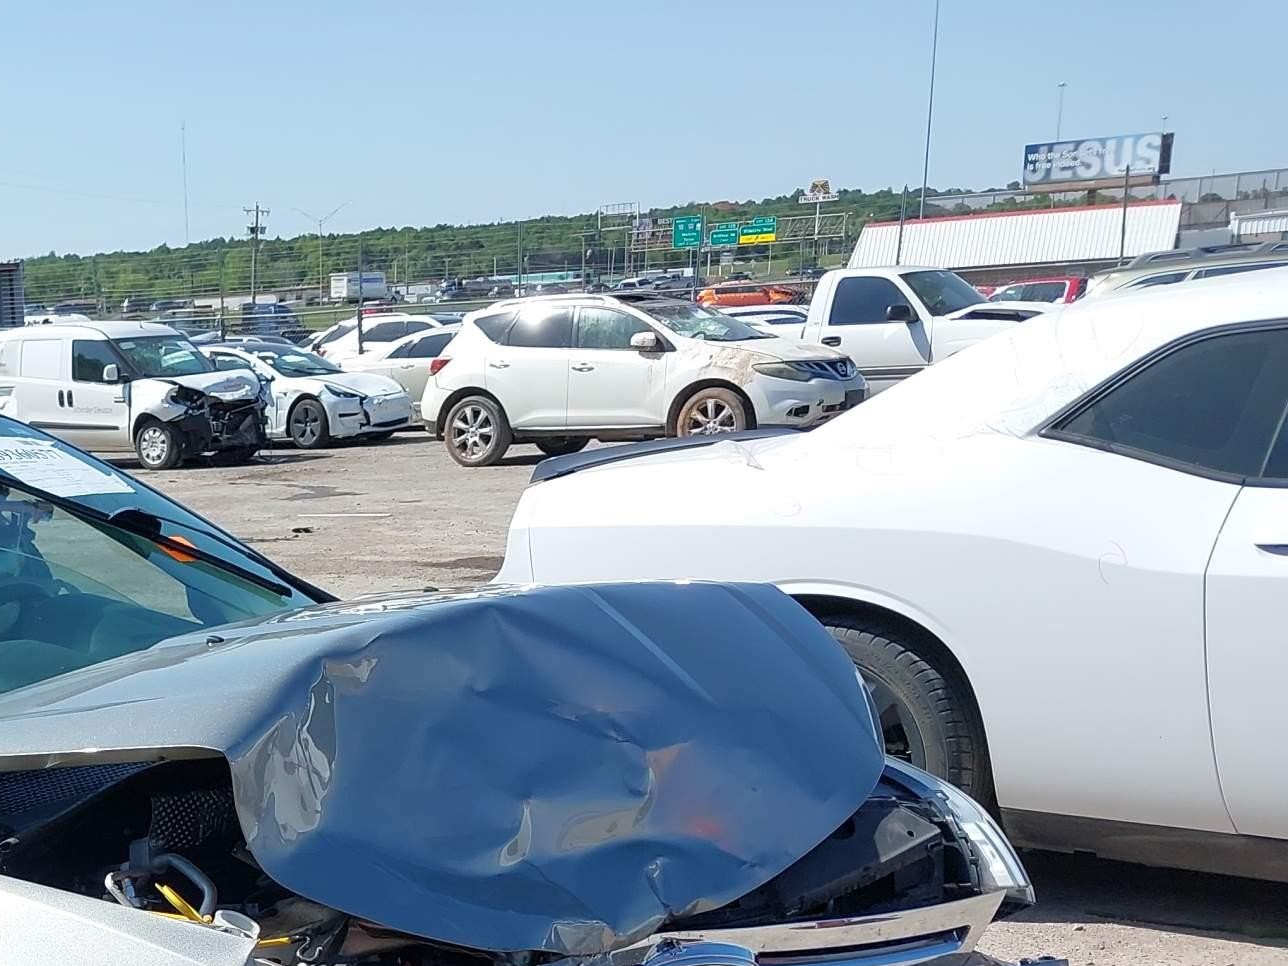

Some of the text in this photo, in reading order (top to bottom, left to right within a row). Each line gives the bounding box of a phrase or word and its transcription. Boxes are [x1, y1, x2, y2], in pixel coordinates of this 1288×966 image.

[1024, 135, 1161, 182] JESUS
[1027, 152, 1046, 162] Who
[1035, 162, 1051, 170] free
[800, 195, 819, 203] TRUCK
